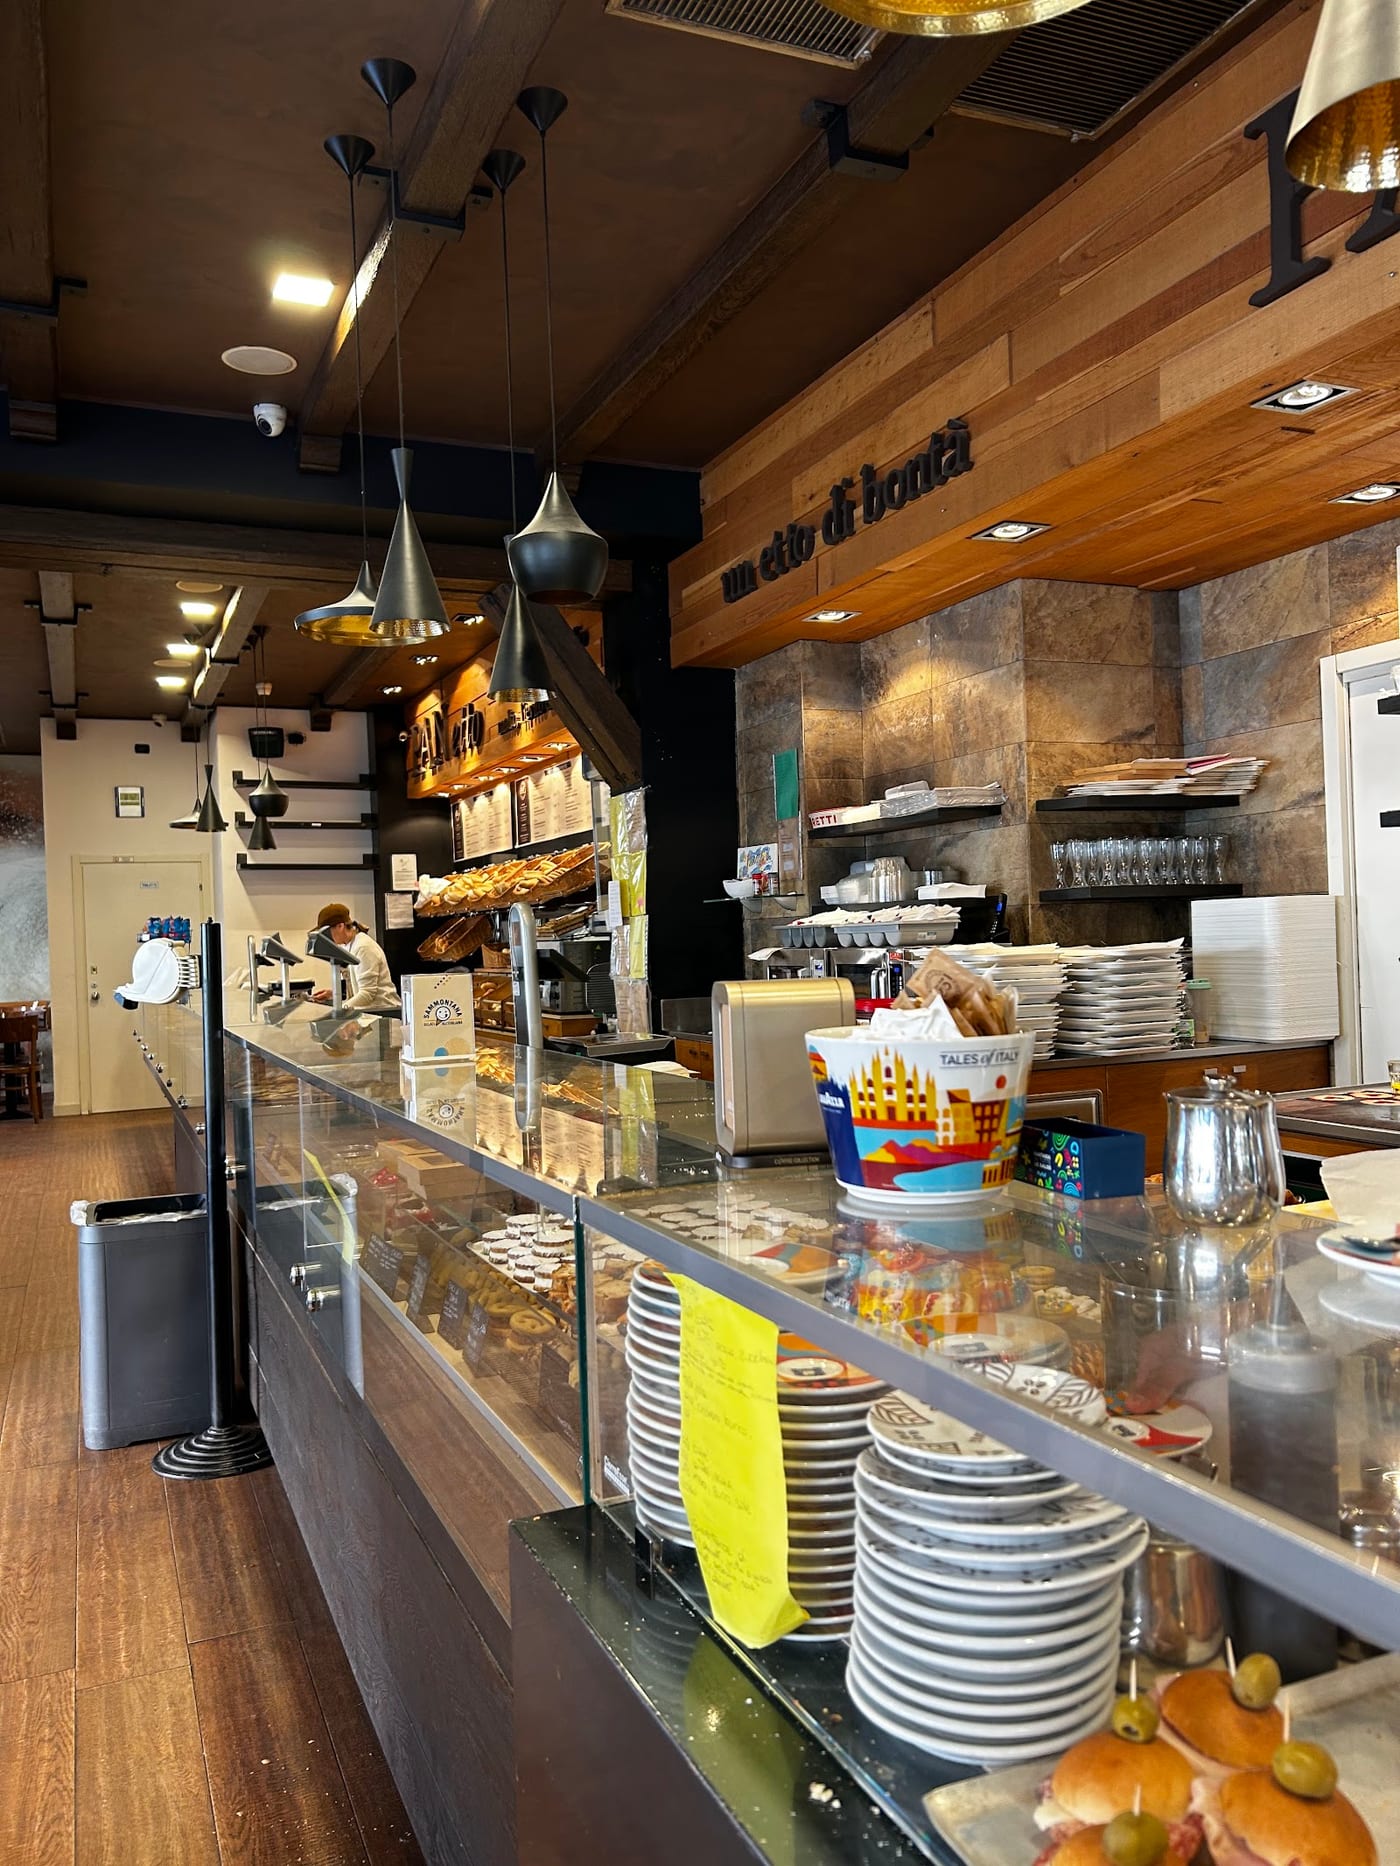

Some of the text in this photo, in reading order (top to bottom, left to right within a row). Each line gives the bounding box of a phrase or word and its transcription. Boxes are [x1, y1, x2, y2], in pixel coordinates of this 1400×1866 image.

[721, 418, 975, 603] un etto di bontà
[423, 999, 463, 1019] SAMMONTANA
[939, 1048, 1019, 1068] TALES of ITALY
